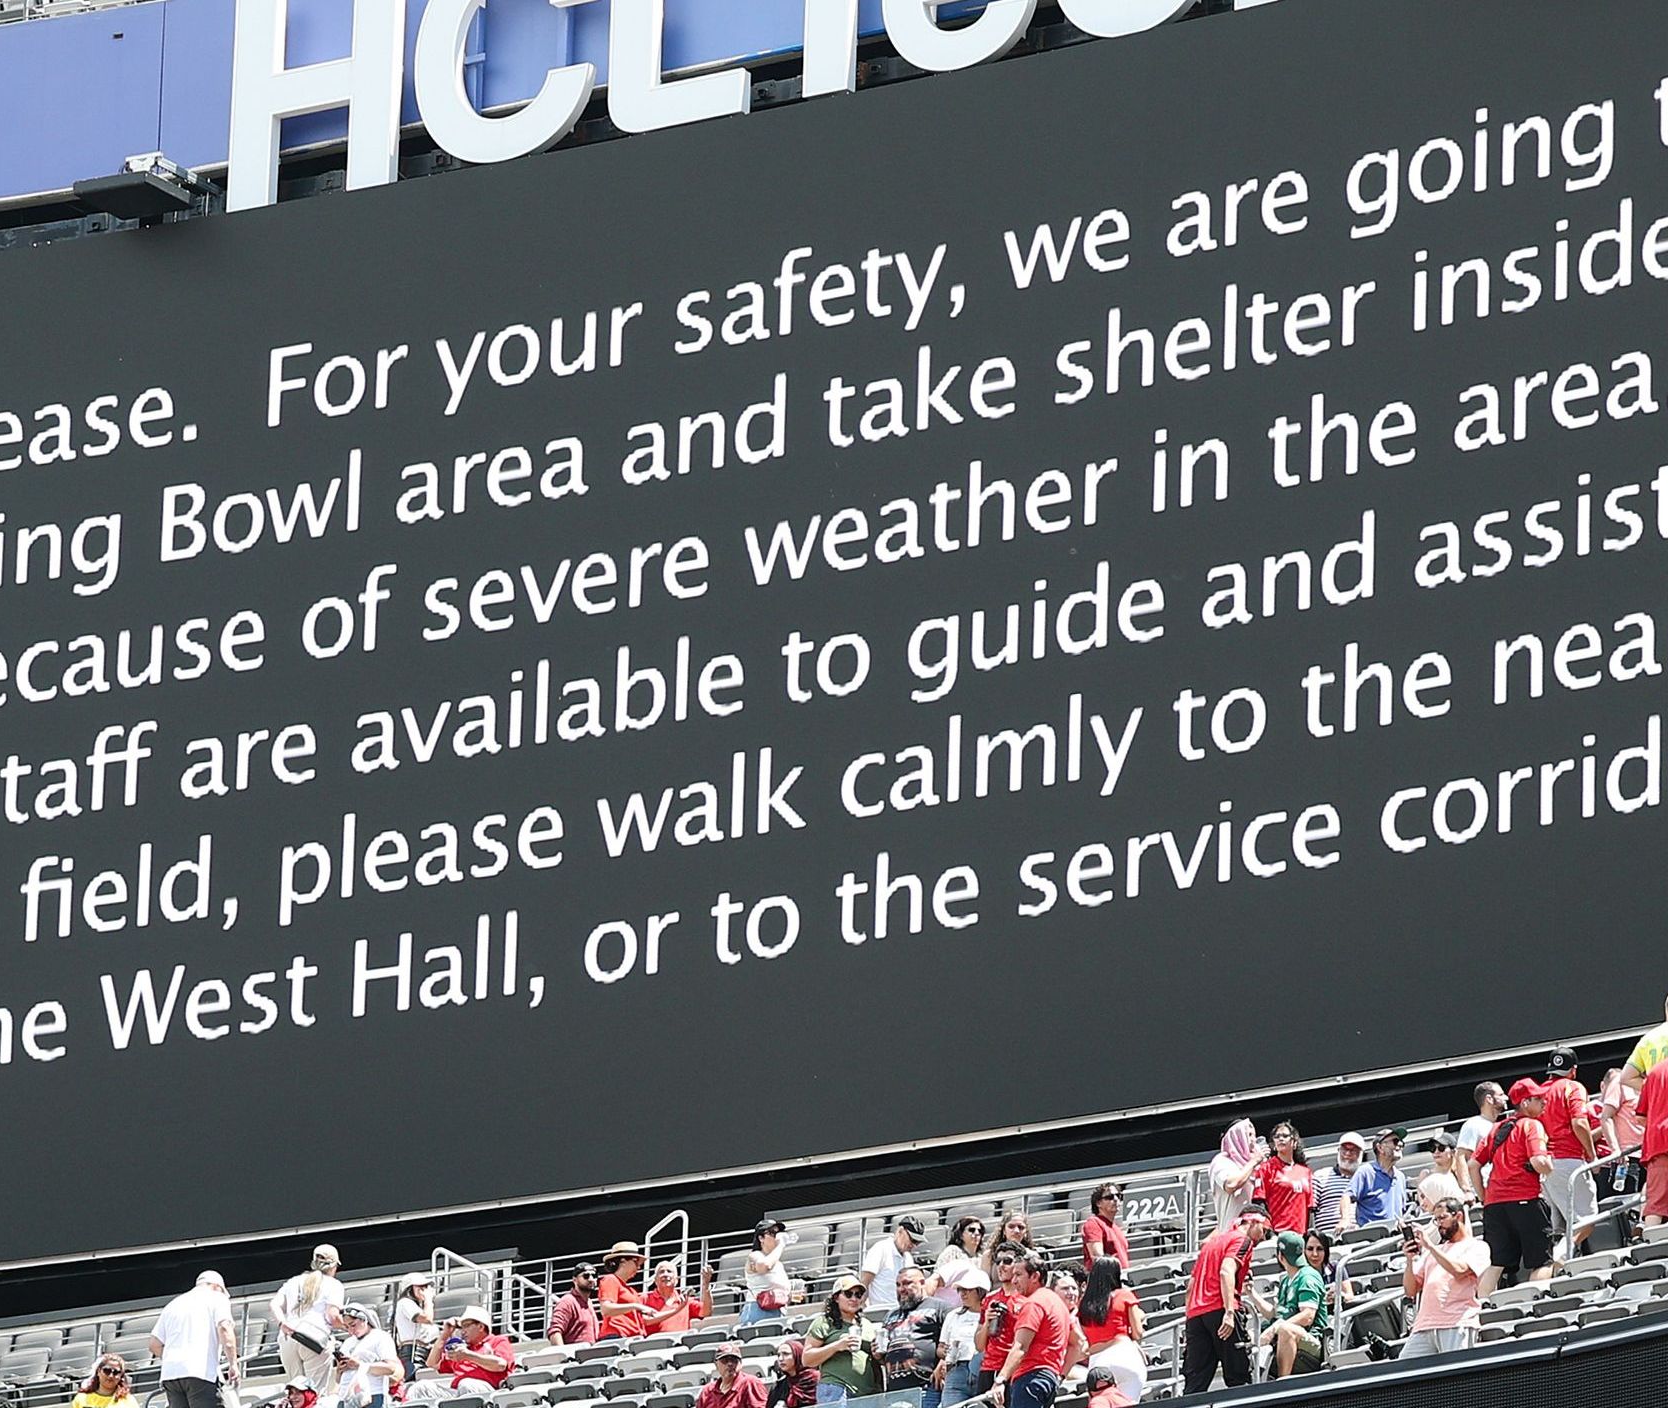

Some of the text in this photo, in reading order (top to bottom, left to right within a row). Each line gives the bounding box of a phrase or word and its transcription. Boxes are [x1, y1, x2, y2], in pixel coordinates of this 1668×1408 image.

[267, 342, 409, 428] For
[435, 301, 643, 416] your
[674, 243, 966, 355] safety,
[1003, 208, 1130, 289] we
[1166, 170, 1309, 257] are
[1346, 99, 1615, 239] going
[160, 448, 362, 562] Bowl
[395, 436, 590, 525] area
[621, 372, 787, 486] and
[822, 344, 1017, 448] take
[1054, 280, 1376, 405] shelter
[301, 563, 398, 659] of
[422, 536, 710, 641] severe
[744, 457, 1118, 586] weather
[1152, 428, 1229, 513] in
[1267, 393, 1417, 488] the
[19, 834, 238, 942] field,
[279, 806, 564, 927] please
[596, 746, 807, 858] walk
[840, 693, 1144, 818] calmly
[1172, 687, 1267, 761] to
[1300, 642, 1452, 738] the
[180, 723, 317, 800] are
[351, 635, 745, 774] available
[781, 631, 871, 704] to
[907, 560, 1165, 704] guide
[1201, 509, 1376, 630] and
[99, 955, 318, 1050] West
[352, 909, 545, 1018] Hall,
[583, 911, 680, 984] or
[710, 892, 800, 965] to
[835, 851, 980, 946] the
[1018, 800, 1341, 917] service
[1126, 1194, 1180, 1222] 222A
